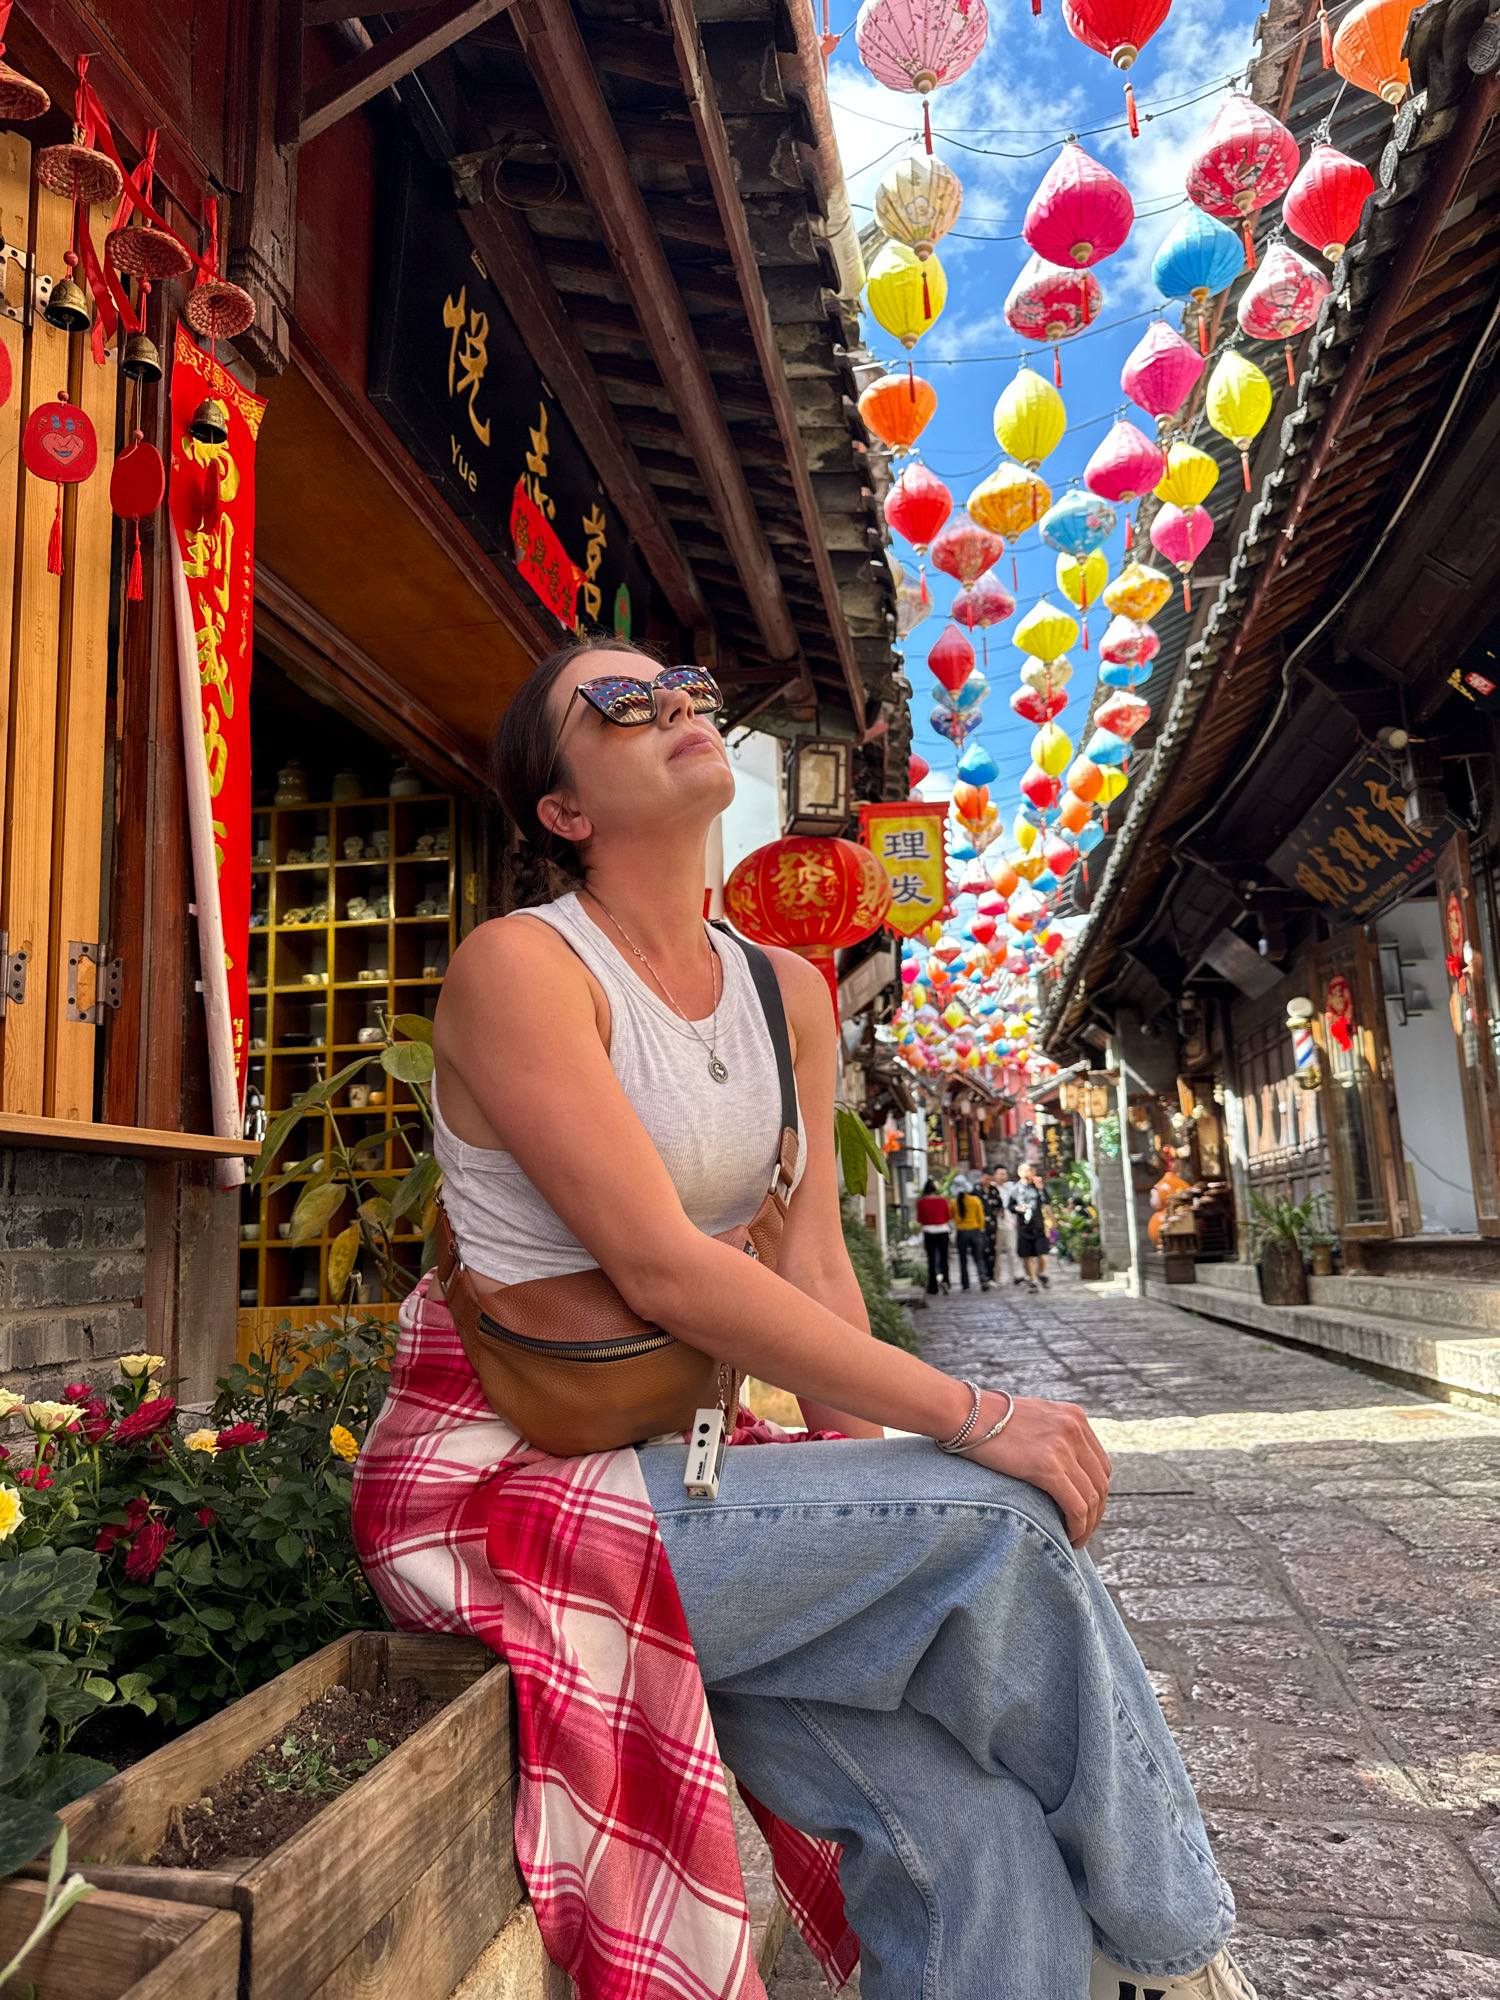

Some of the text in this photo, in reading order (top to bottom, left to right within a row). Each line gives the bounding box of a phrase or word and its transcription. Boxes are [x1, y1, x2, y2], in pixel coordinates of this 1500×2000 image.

[451, 434, 477, 493] Yue
[770, 851, 836, 908] 發
[882, 830, 934, 905] 理发
